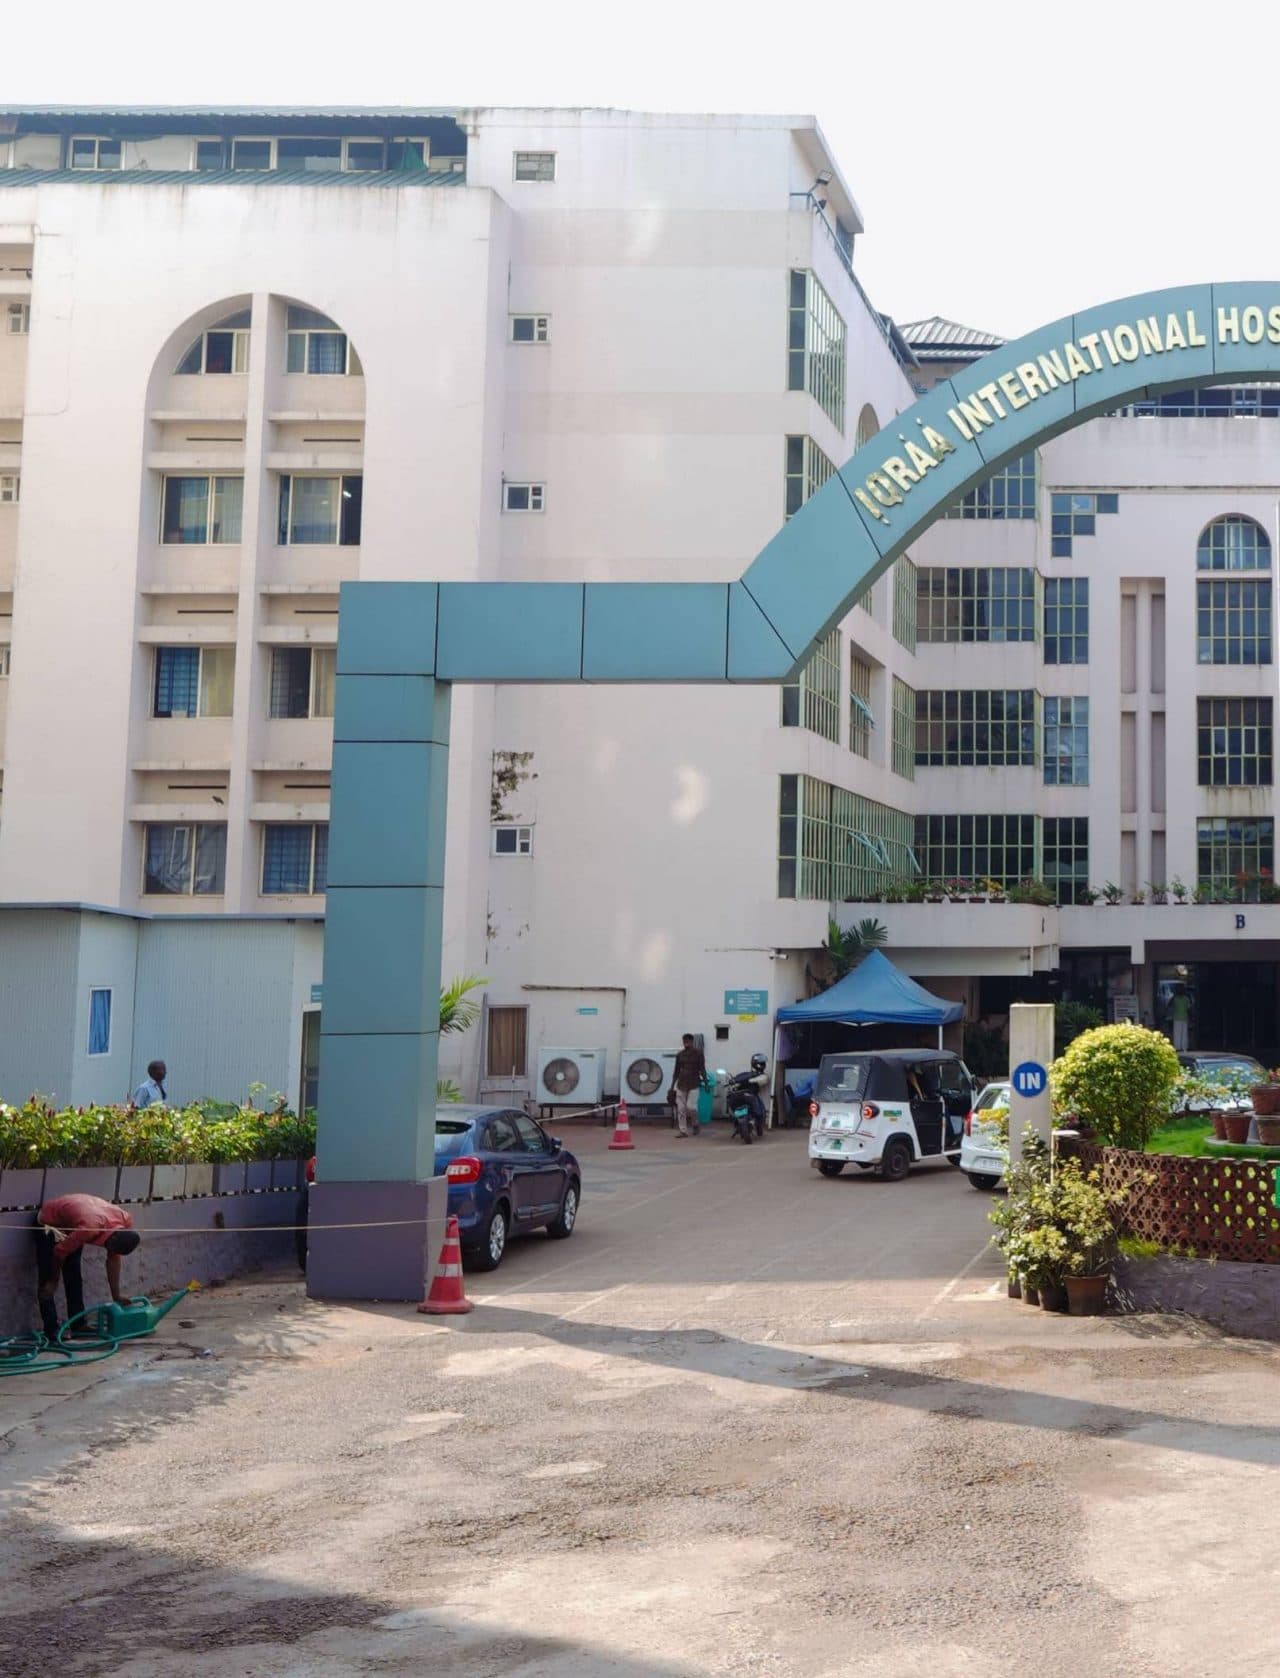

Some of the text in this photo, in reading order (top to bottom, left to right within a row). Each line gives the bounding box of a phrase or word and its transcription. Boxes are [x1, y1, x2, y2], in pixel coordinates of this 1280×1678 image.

[946, 310, 1206, 441] INTERNATIONAL
[1235, 914, 1245, 929] B
[1019, 1072, 1041, 1090] IN
